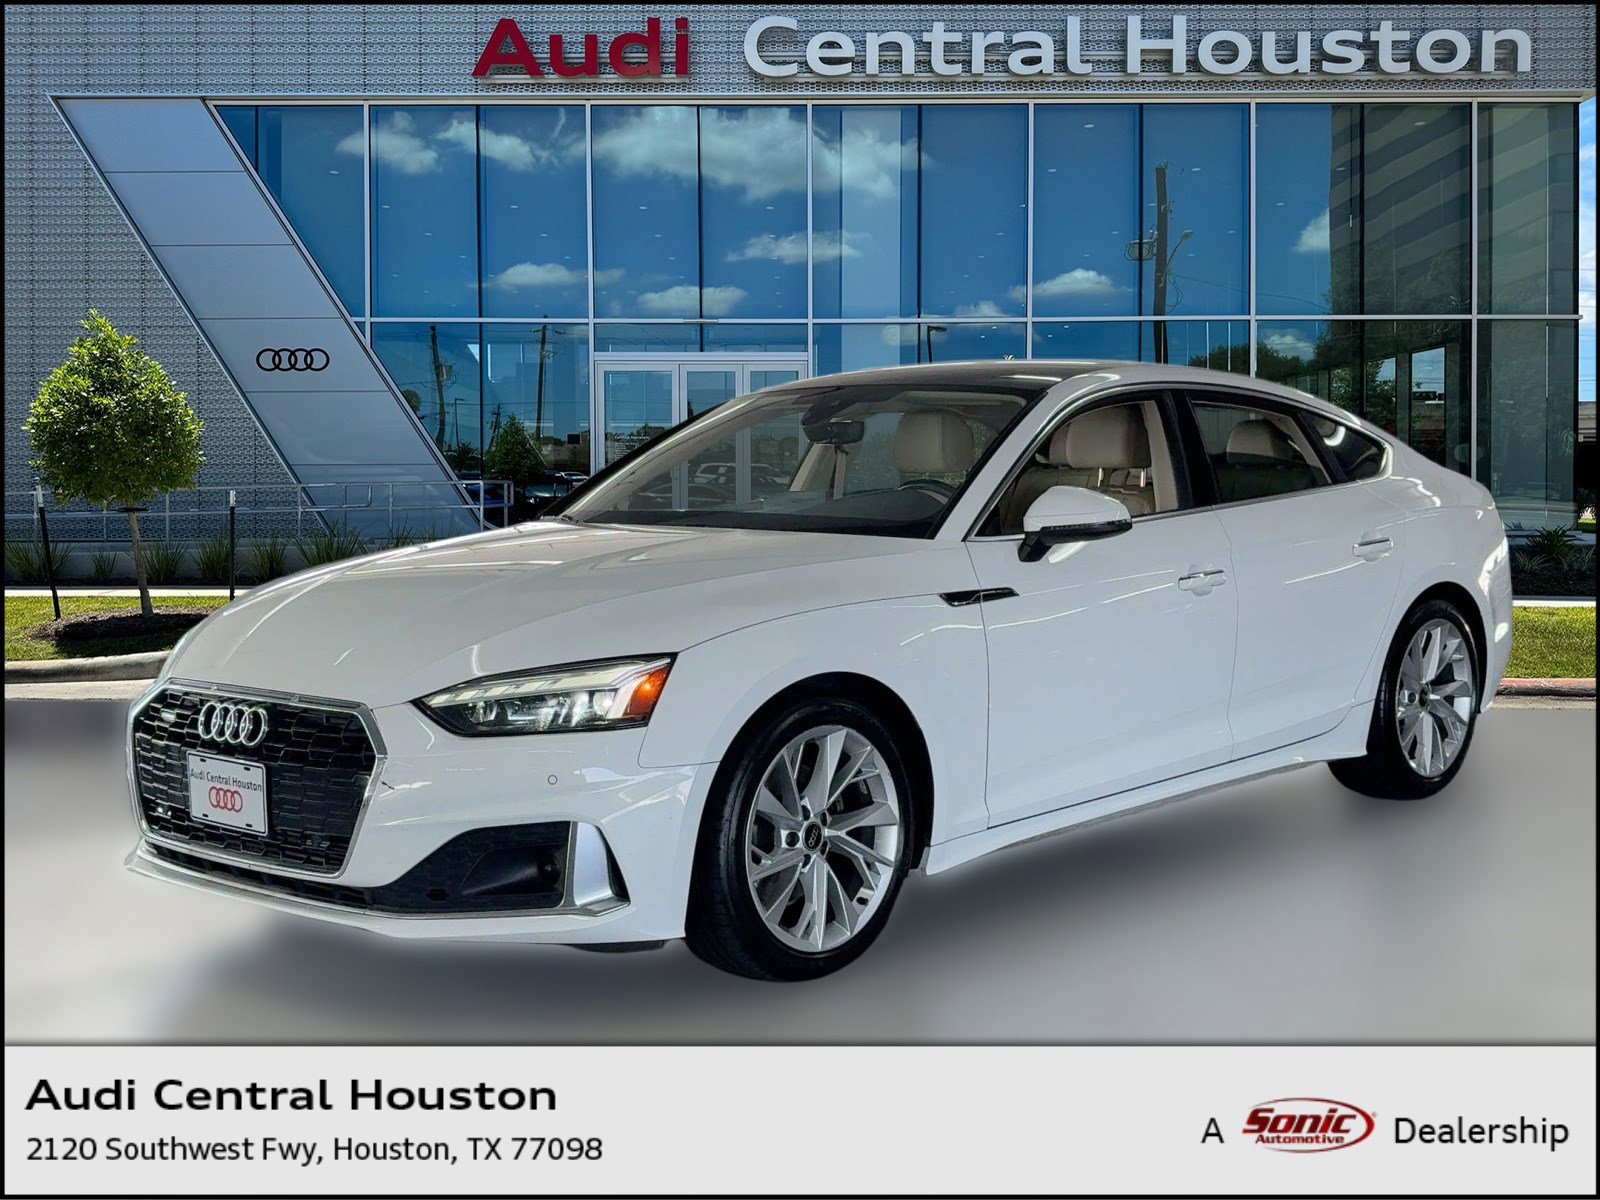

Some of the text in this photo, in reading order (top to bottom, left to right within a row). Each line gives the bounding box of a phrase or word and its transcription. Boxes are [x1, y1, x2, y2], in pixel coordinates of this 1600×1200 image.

[471, 15, 1532, 78] Audi Central Houston
[190, 768, 263, 792] Audi Central Houston
